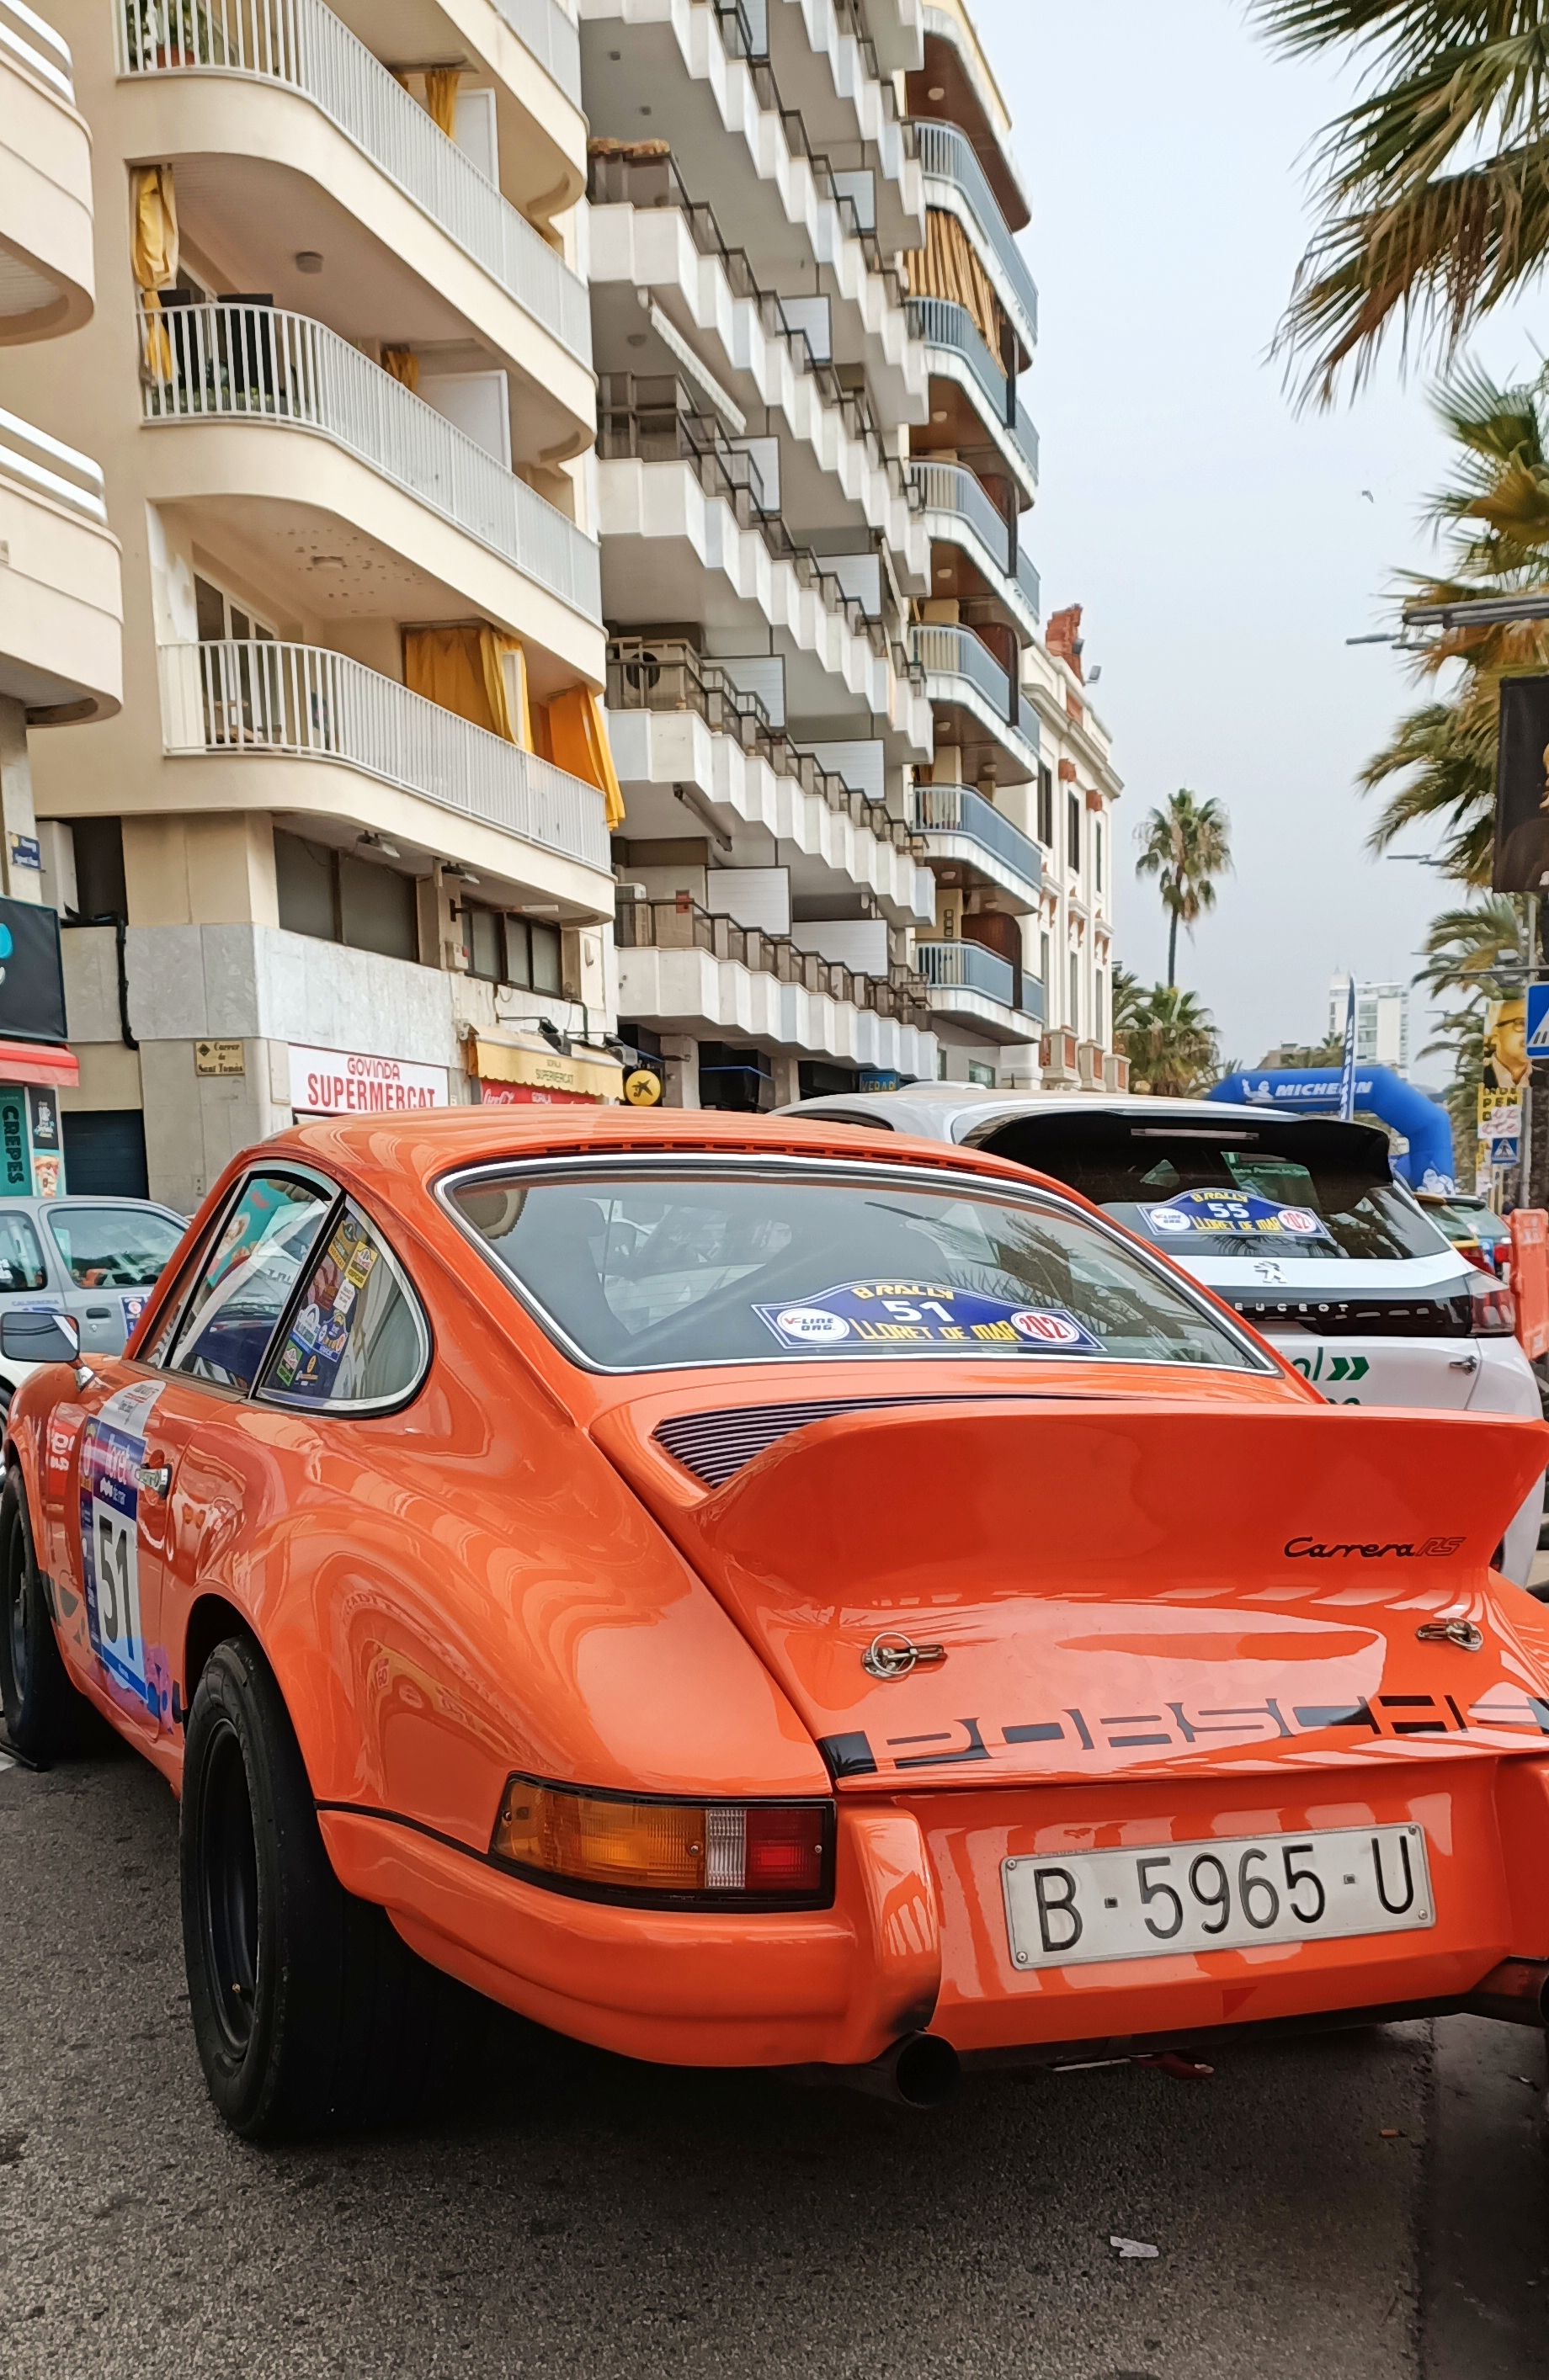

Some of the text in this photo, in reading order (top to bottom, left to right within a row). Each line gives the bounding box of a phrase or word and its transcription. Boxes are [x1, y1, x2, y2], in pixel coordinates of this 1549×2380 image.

[347, 1057, 401, 1081] GOVINDA
[307, 1073, 435, 1113] SUPERMERCAT
[3, 1105, 24, 1184] CREPES
[1202, 1192, 1248, 1203] RALLY
[1207, 1203, 1250, 1218] 55
[1189, 1214, 1285, 1231] LLORET DE MAR
[876, 1284, 955, 1300] RALLY
[881, 1301, 955, 1322] 51
[1234, 1302, 1349, 1312] EUGEOT
[848, 1317, 1025, 1341] LLORET DE MAR
[1019, 1315, 1072, 1339] 2021
[1284, 1536, 1466, 1558] Carrera RS
[98, 1513, 135, 1661] 51
[871, 1693, 1542, 1771] PORSCHE
